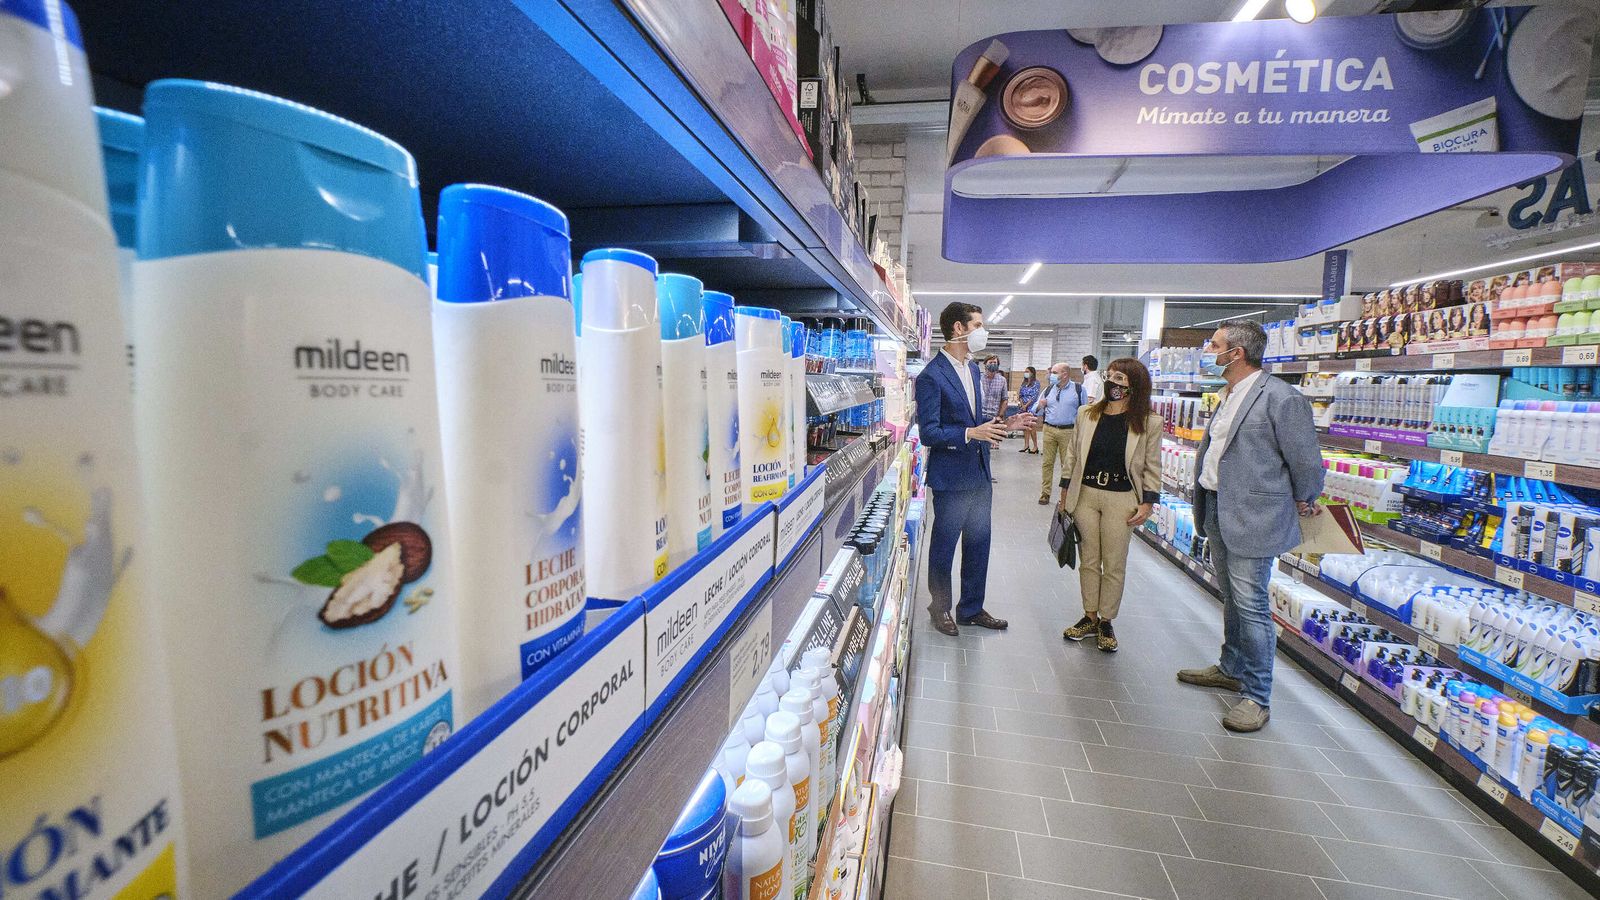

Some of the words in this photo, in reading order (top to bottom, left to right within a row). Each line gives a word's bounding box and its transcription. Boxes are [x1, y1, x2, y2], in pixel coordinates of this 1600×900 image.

[1138, 49, 1394, 95] COSMÉTICA
[1136, 106, 1227, 125] Mímate
[1233, 111, 1252, 125] a
[1258, 107, 1285, 125] tu
[1289, 107, 1391, 125] manera
[1433, 127, 1488, 153] BIOCURA
[1330, 255, 1338, 282] CABELLO
[294, 339, 411, 374] mildeen
[309, 384, 360, 398] BODY
[368, 385, 405, 398] CARE
[753, 460, 782, 474] LOCIÓN
[825, 455, 851, 485] BELLINE
[754, 489, 767, 499] CON
[525, 547, 575, 586] LECHE
[704, 577, 723, 605] LECHE
[729, 554, 748, 581] LOCIÓN
[748, 532, 771, 561] CORPORAL
[838, 557, 863, 601] MAYBELLINE
[657, 601, 698, 657] mildeen
[843, 615, 867, 671] MAYBELLINE
[526, 646, 551, 666] CON
[660, 652, 679, 678] BODY
[679, 633, 695, 658] CARE
[752, 631, 770, 679] 2,79
[260, 641, 414, 722] LOCIÓN
[262, 659, 449, 763] NUTRITIVA
[263, 776, 311, 803] CON
[314, 743, 390, 783] MANTECA
[391, 730, 410, 748] DE
[459, 736, 550, 845] LOCIÓN
[556, 658, 634, 748] CORPORAL
[265, 779, 354, 824] MANTECA
[356, 766, 378, 785] DE
[443, 825, 499, 892] SENSIBLES
[507, 803, 519, 824] PH
[491, 796, 540, 858] MINERALES
[1557, 836, 1574, 851] 2,49
